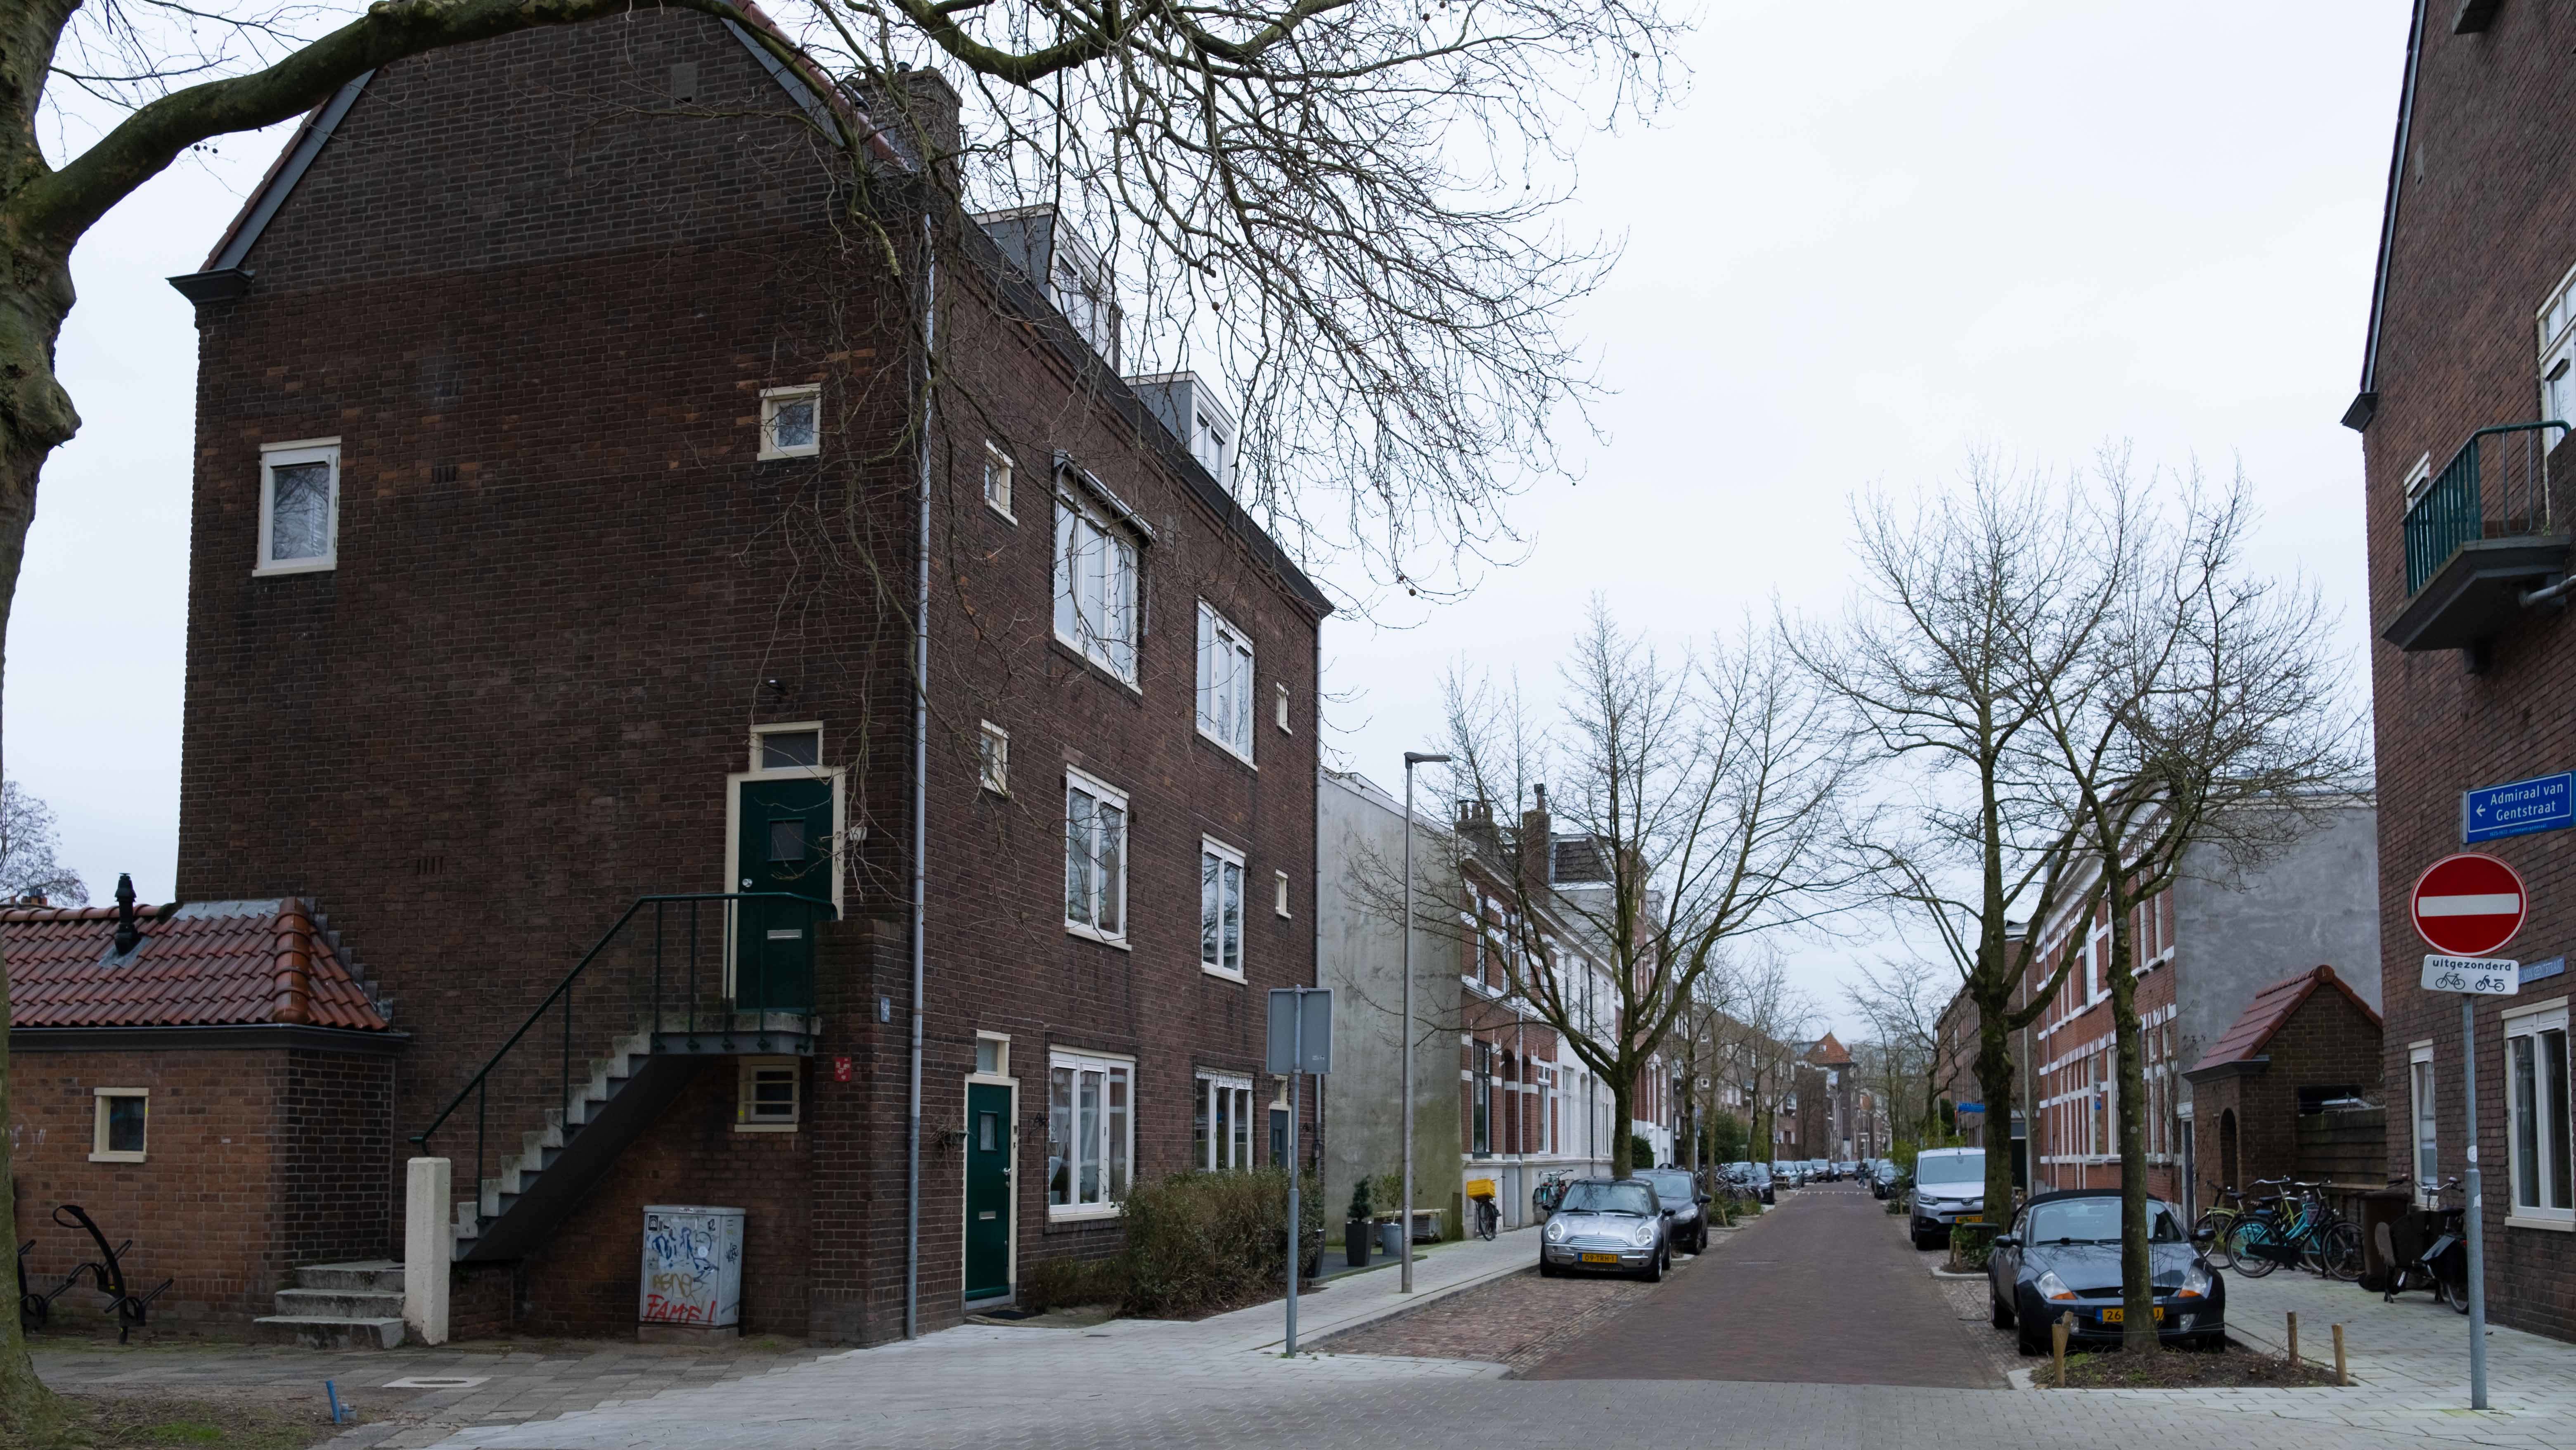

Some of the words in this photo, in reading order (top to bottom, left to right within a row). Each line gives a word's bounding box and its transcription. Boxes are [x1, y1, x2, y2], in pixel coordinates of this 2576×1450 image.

[2491, 785, 2539, 806] Admiraal
[2543, 783, 2563, 796] van
[2496, 801, 2556, 821] Gentstraat
[2433, 958, 2511, 971] uitgezonderd
